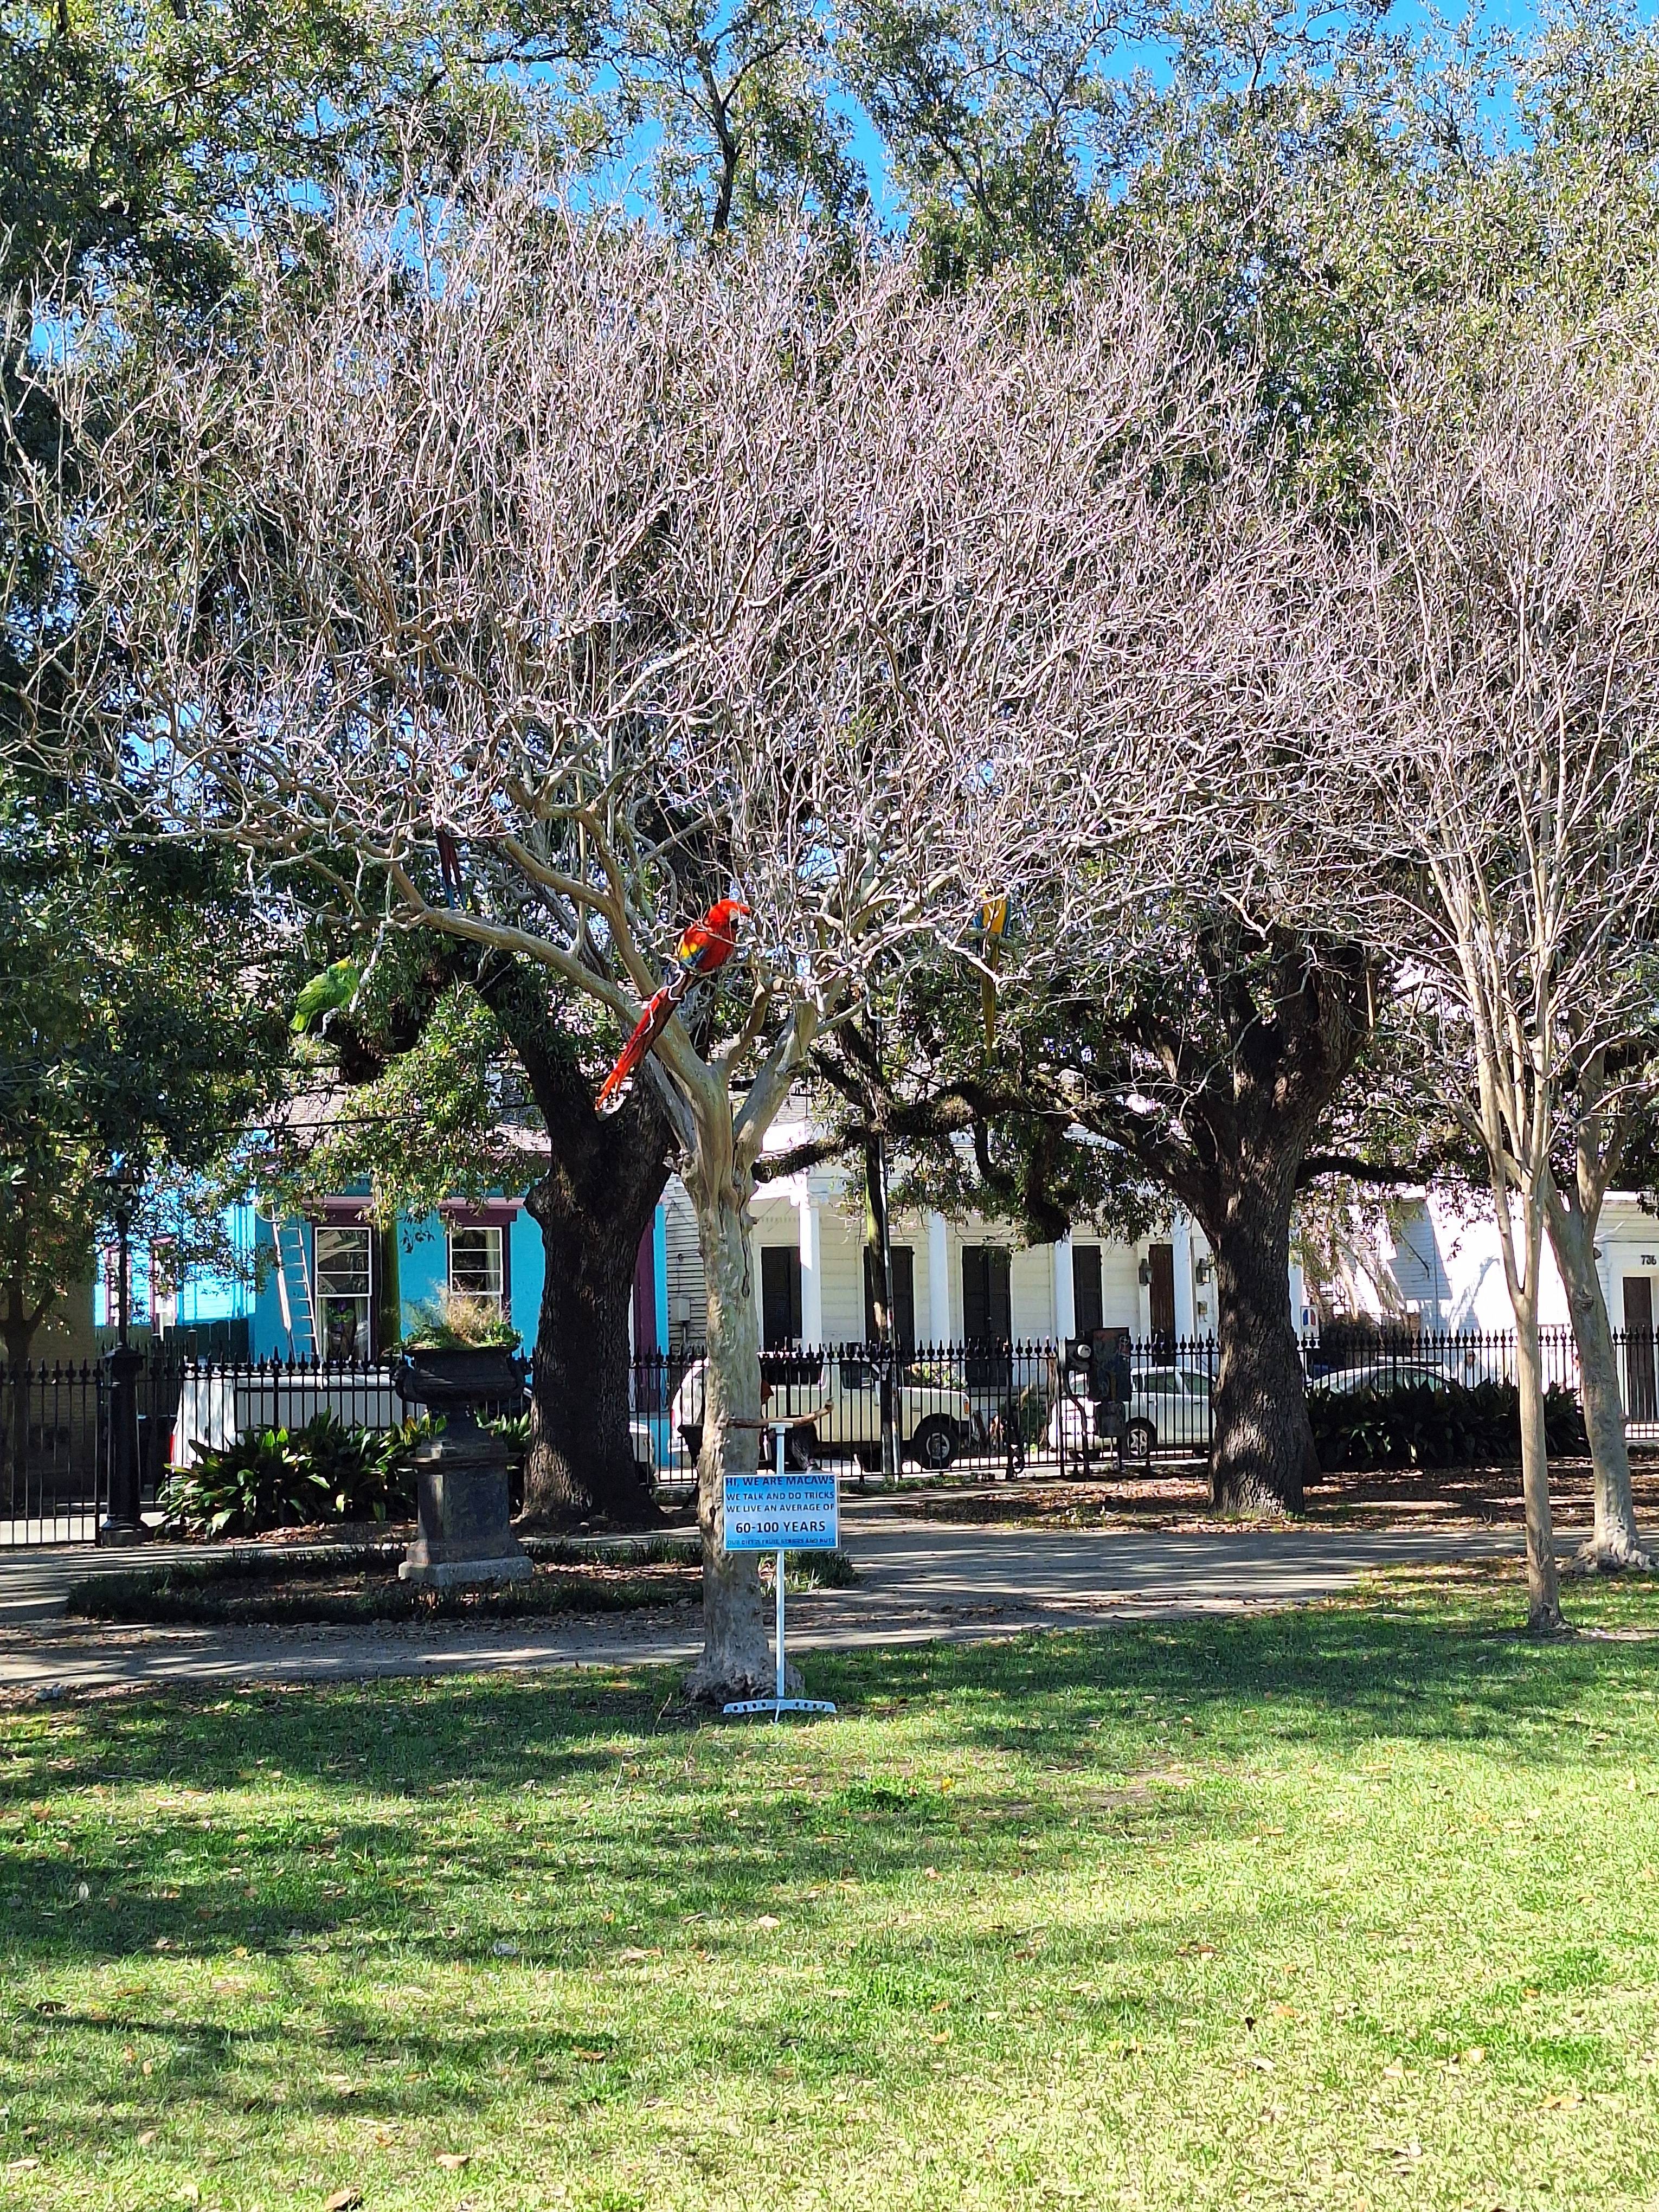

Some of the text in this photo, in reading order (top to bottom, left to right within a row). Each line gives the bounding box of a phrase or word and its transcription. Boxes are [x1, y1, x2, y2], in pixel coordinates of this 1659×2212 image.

[726, 1476, 834, 1487] HI, WE ARE MACAWS
[736, 1521, 826, 1533] 60-100 YEARS
